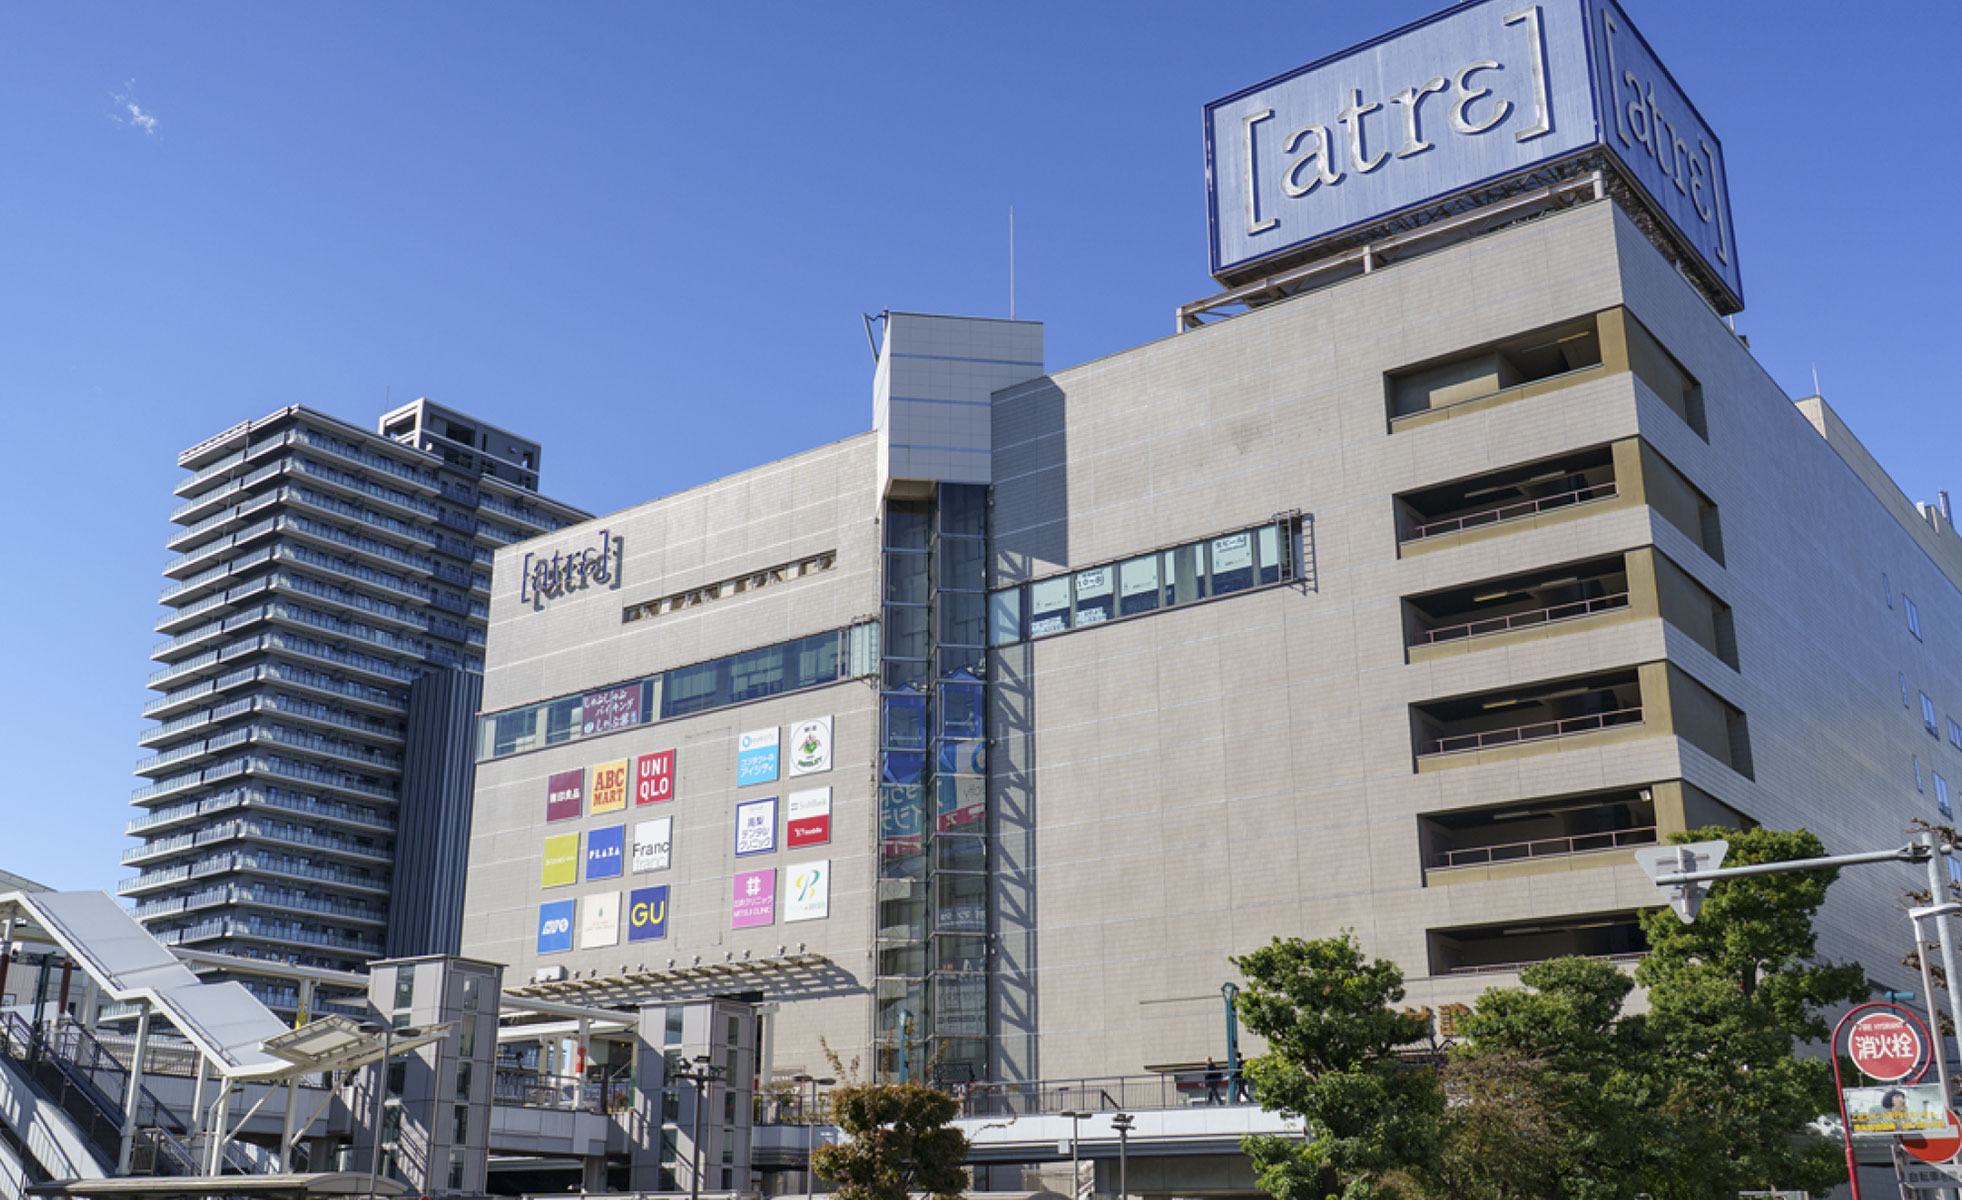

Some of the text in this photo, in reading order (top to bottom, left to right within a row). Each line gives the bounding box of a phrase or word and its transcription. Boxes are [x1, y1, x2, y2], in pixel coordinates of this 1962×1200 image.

[641, 757, 668, 778] UNI
[594, 768, 625, 792] ABC
[640, 777, 669, 800] QLO
[593, 788, 623, 806] MART
[589, 845, 620, 860] PLAZA
[633, 841, 671, 858] Franc
[631, 900, 665, 927] GU
[1855, 1033, 1914, 1060] 消火栓
